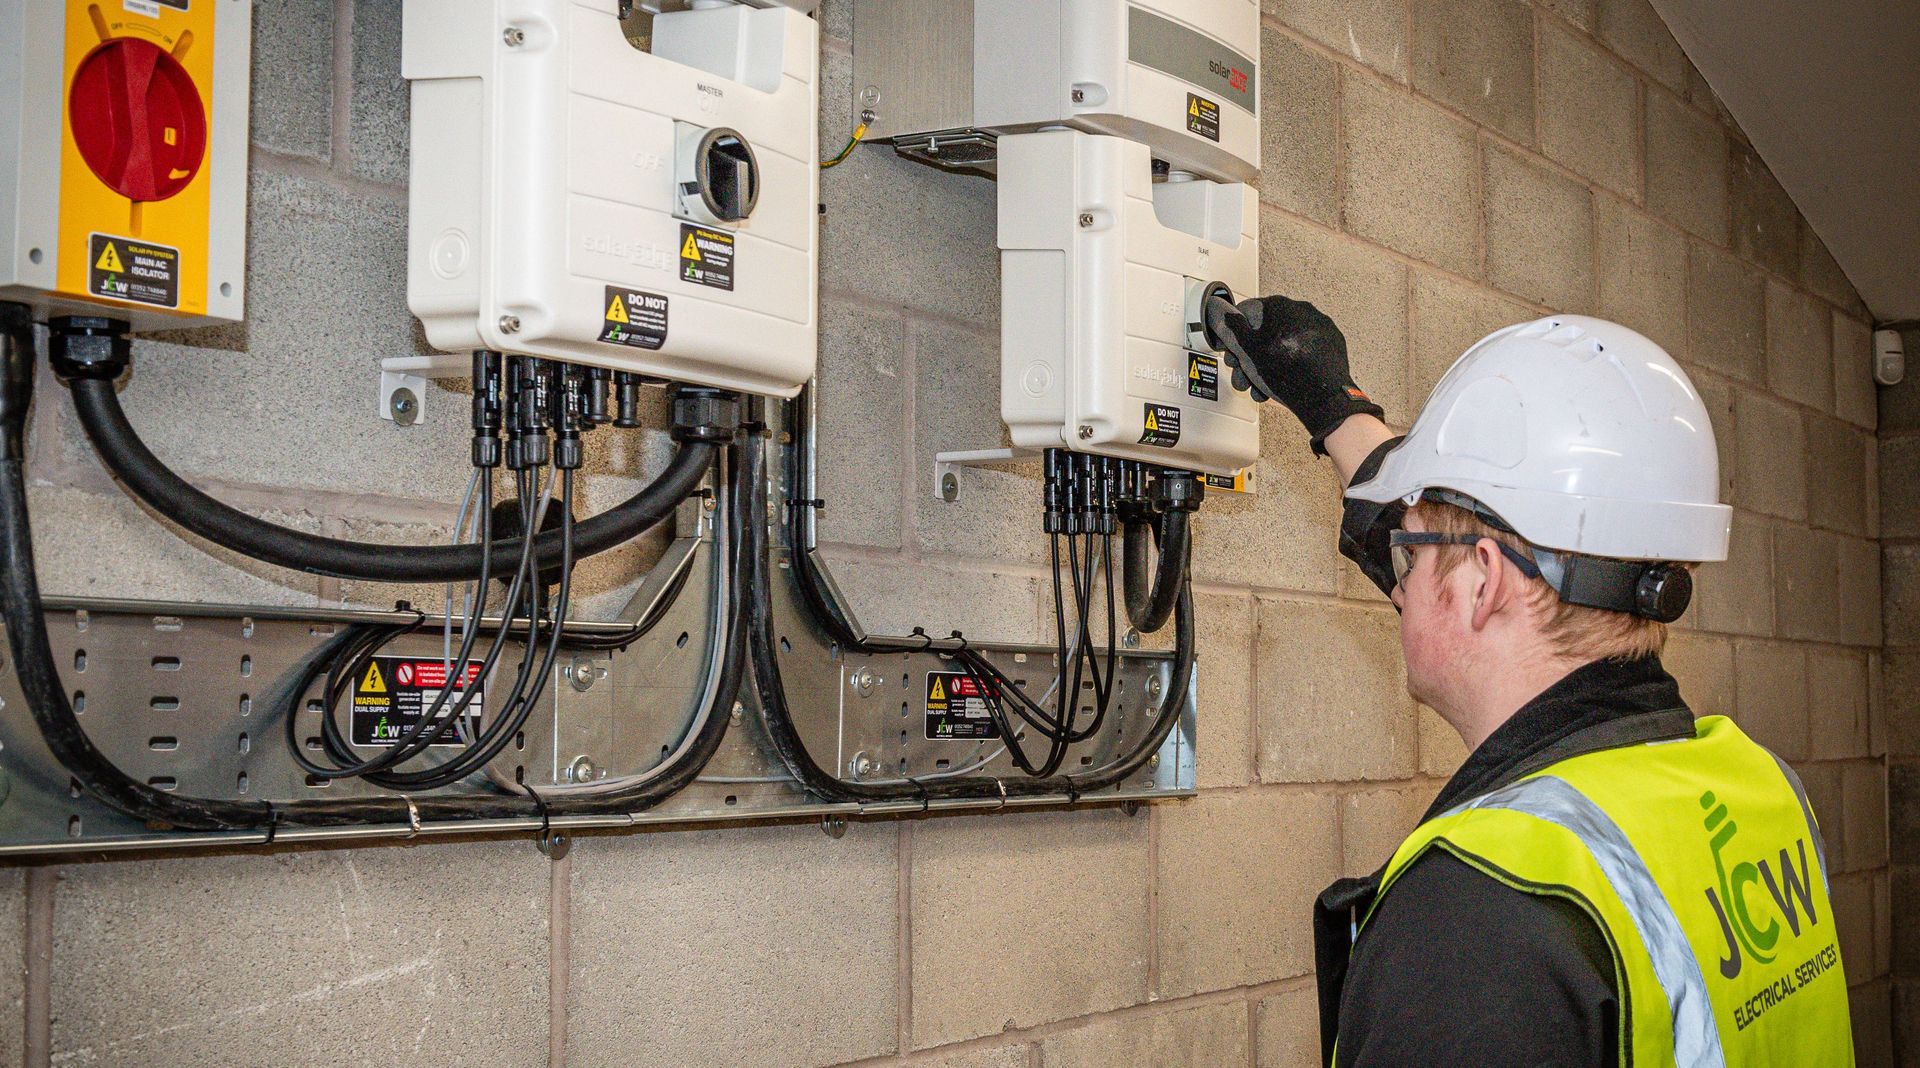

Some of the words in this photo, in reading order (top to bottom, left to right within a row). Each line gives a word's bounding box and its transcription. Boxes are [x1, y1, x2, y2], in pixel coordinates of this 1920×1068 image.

[111, 22, 123, 30] OFF
[163, 34, 173, 44] ON
[697, 83, 723, 98] MASTER
[633, 152, 664, 171] OFF
[697, 239, 733, 256] WARNING
[135, 256, 154, 267] MAIN
[155, 260, 168, 269] AC
[131, 266, 170, 280] ISOLATOR
[628, 294, 644, 306] DO
[645, 297, 667, 310] NOT
[1197, 363, 1217, 375] WARNING
[1157, 408, 1166, 417] DO
[1167, 410, 1179, 419] NOT
[355, 697, 390, 706] WARNING
[371, 721, 400, 738] JCW
[937, 721, 953, 734] JCW
[1703, 815, 1818, 980] JCW
[1733, 974, 1796, 1032] ELECTRICAL
[1795, 943, 1837, 988] SERVICES
